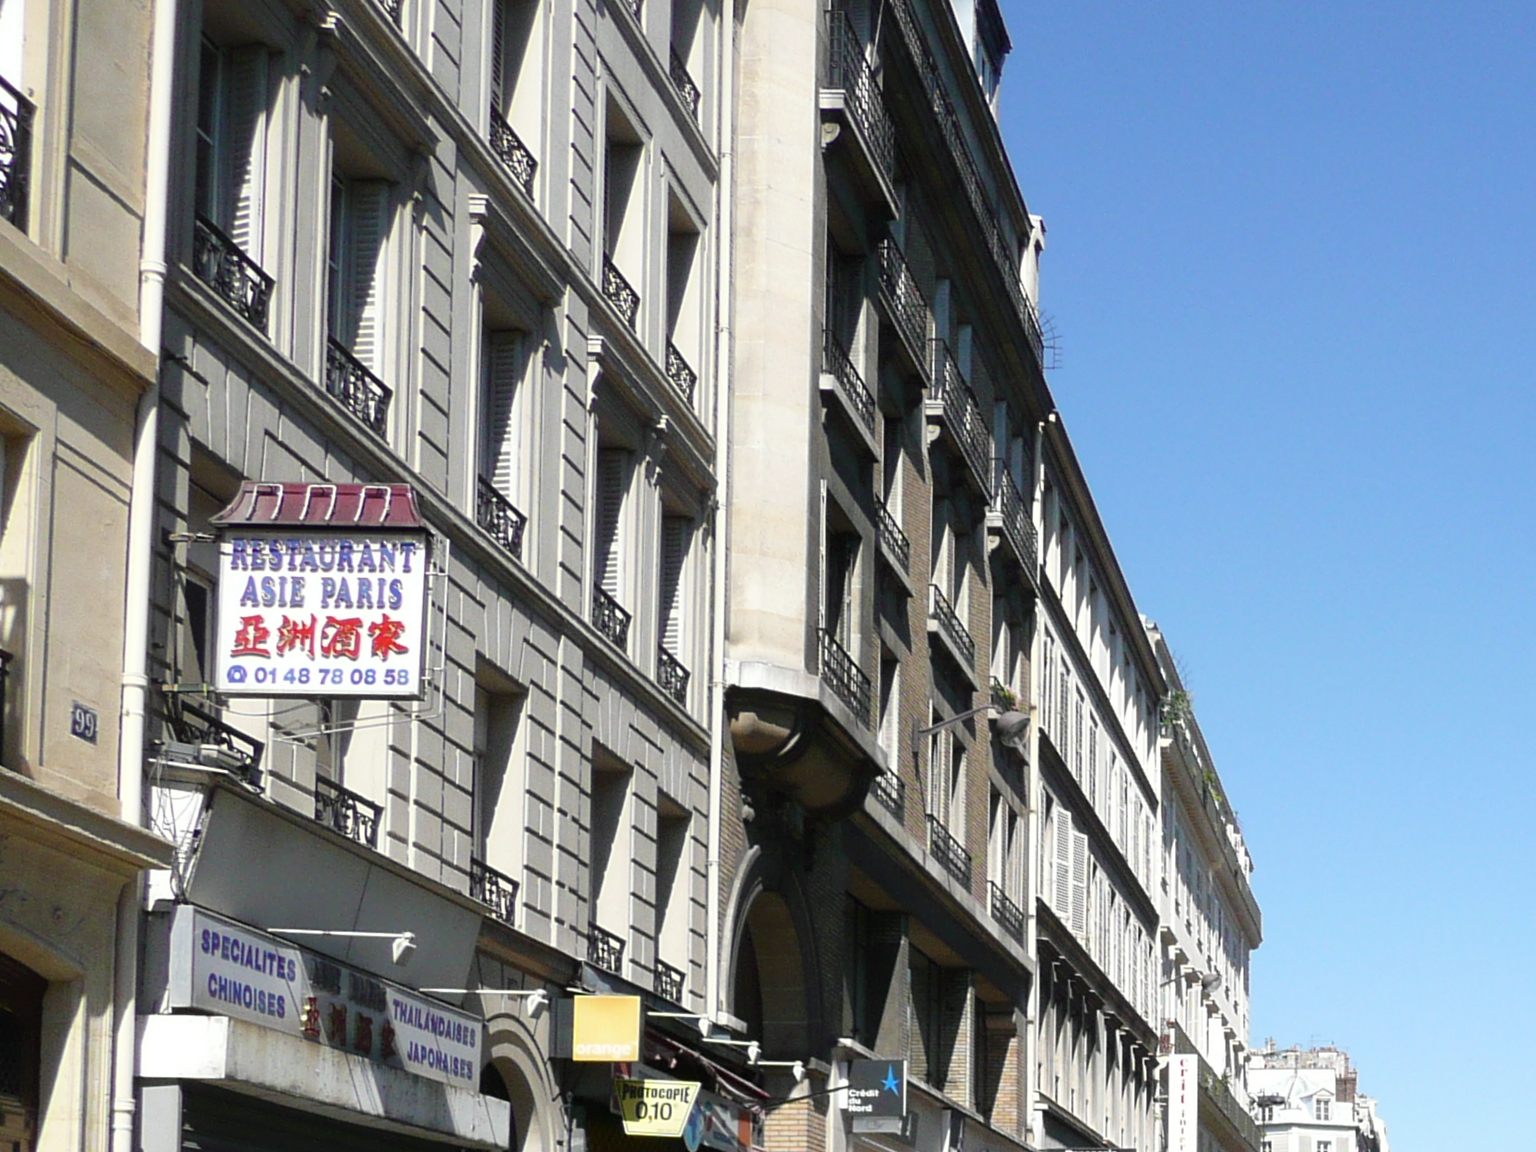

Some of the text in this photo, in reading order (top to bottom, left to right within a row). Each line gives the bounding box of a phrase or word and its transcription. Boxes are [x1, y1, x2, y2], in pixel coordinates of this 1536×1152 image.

[230, 538, 417, 573] RESTAURANT
[240, 575, 404, 610] ASIE PARIS
[230, 613, 410, 661] 亞洲酒家
[254, 667, 410, 685] 01 48 78 08 58
[75, 708, 95, 738] 99
[200, 927, 297, 983] SPECIALITES
[207, 972, 286, 1019] CHINOISES
[392, 998, 477, 1049] THAILANDAISES
[407, 1040, 473, 1081] JAPONAISES
[576, 1043, 632, 1058] orange
[622, 1083, 691, 1104] PHOTOCOPIE
[848, 1088, 880, 1099] Crédit
[848, 1097, 861, 1106] du
[848, 1104, 873, 1113] Nord
